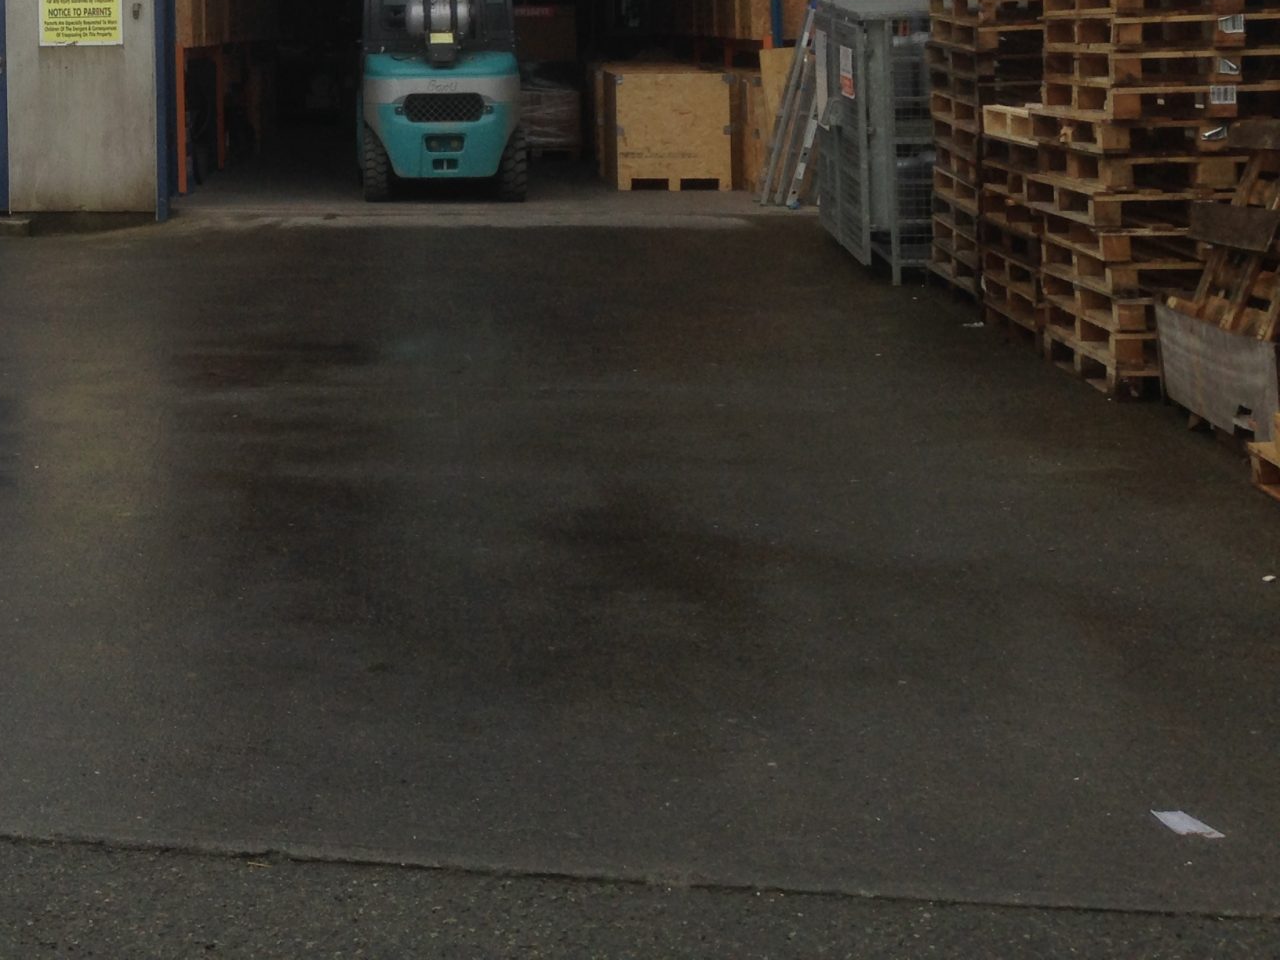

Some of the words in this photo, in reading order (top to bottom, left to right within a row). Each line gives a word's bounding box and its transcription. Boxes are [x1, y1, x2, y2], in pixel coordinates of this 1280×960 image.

[48, 8, 71, 17] NOTICE
[73, 8, 81, 16] TO
[84, 7, 112, 16] PARENTS
